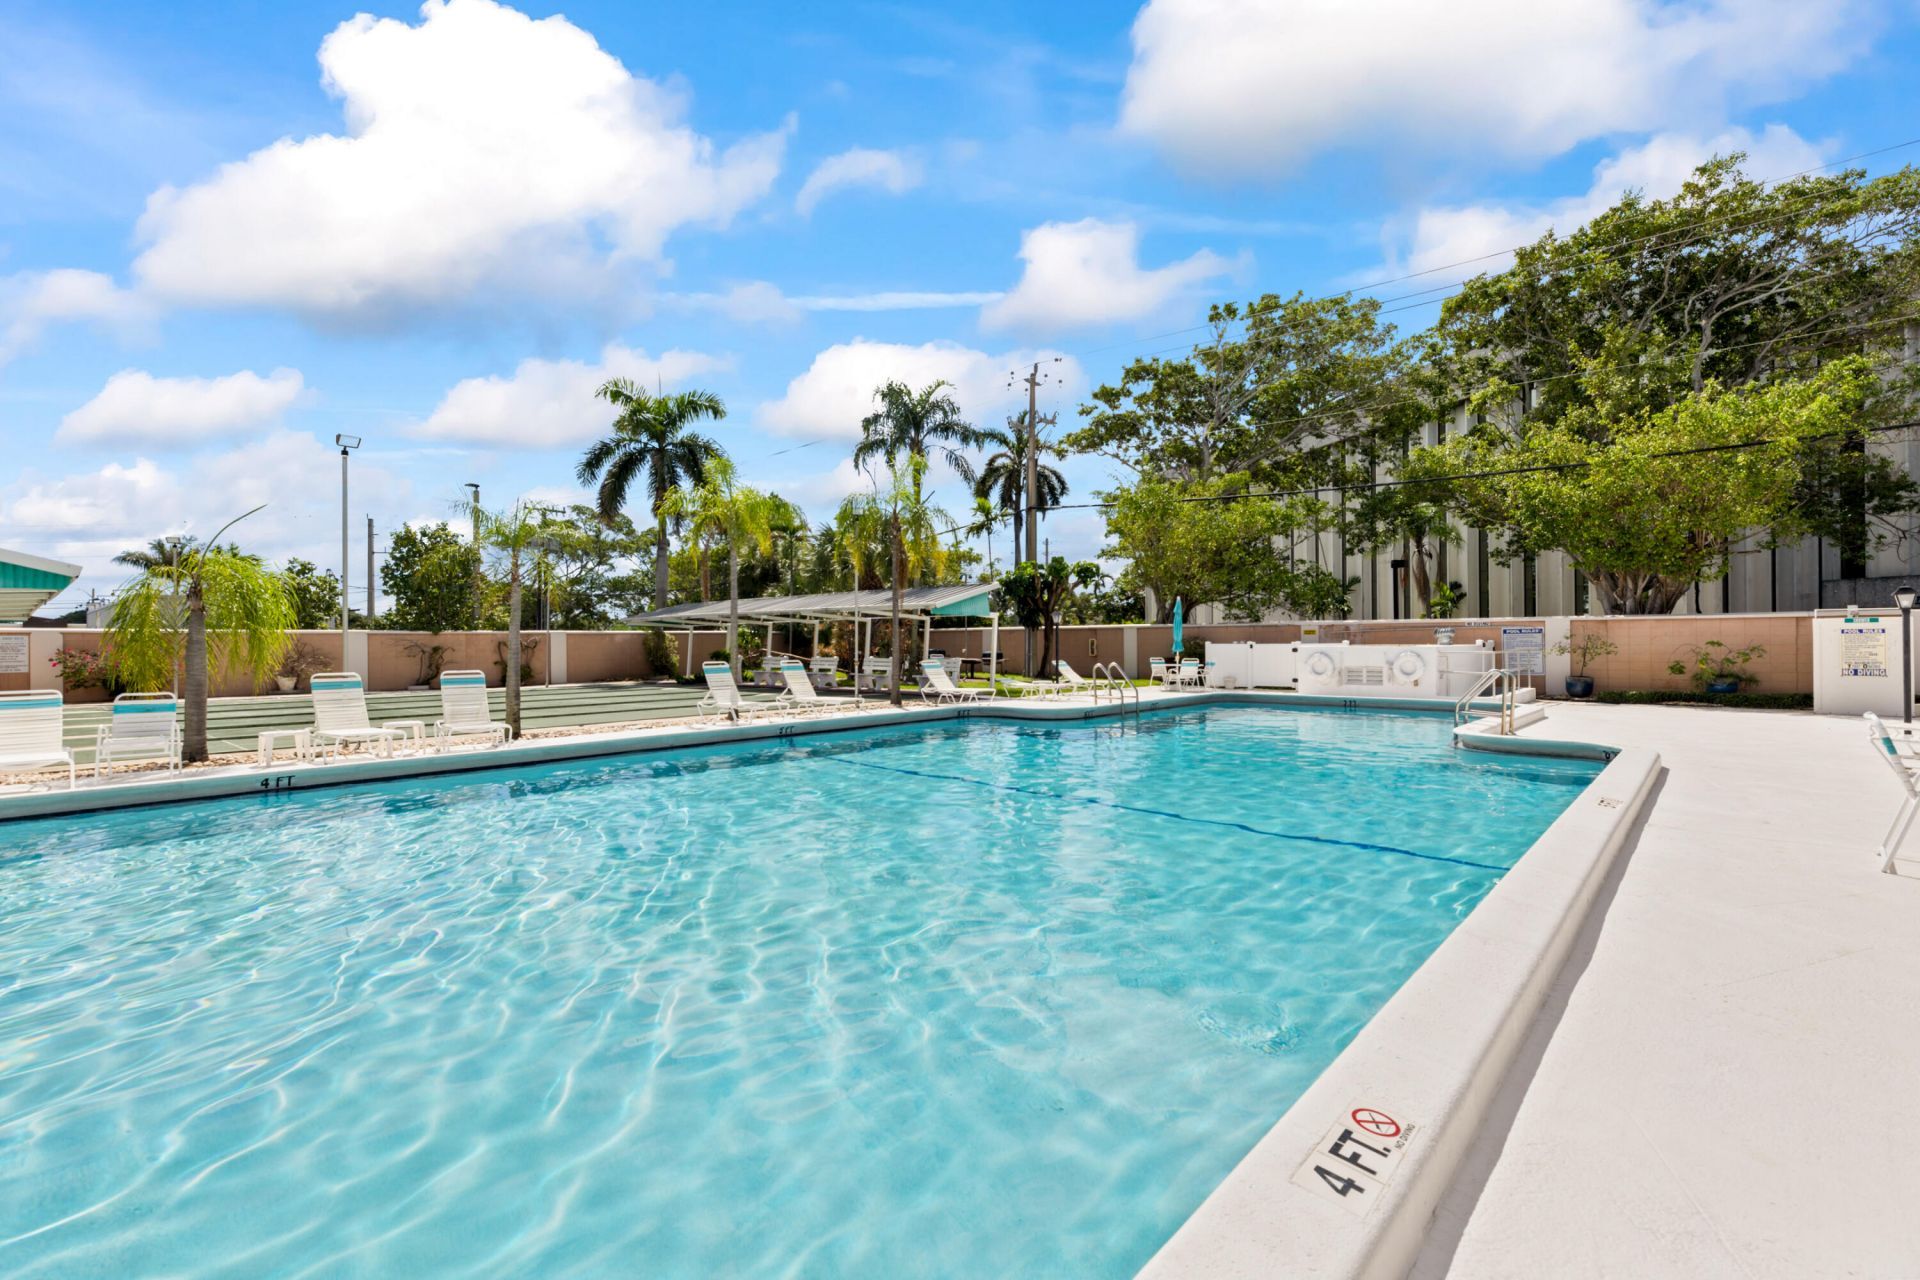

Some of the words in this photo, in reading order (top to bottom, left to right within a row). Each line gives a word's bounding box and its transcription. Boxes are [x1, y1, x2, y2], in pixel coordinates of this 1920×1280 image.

[1843, 668, 1855, 676] NO
[1857, 668, 1886, 677] DIVING
[261, 778, 270, 789] 4
[276, 775, 296, 788] FT
[1328, 1128, 1391, 1176] FT.
[1313, 1165, 1365, 1197] 4
